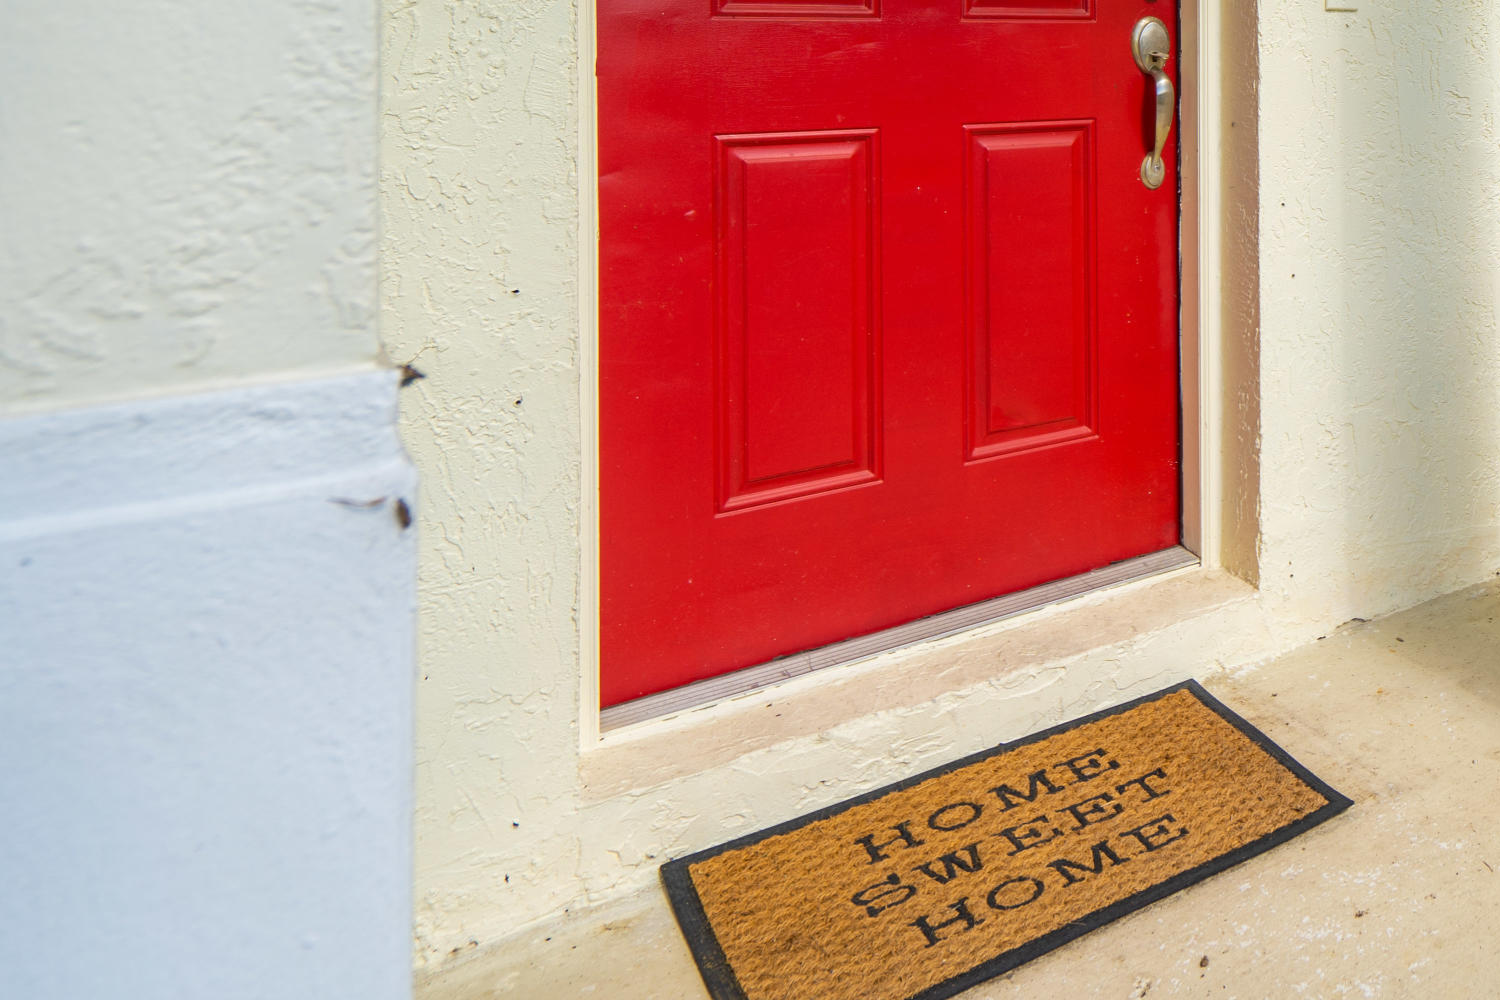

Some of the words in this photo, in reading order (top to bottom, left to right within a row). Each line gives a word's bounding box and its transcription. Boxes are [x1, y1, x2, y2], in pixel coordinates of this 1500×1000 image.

[851, 767, 1170, 918] SWEET
[854, 748, 1122, 864] HOME
[909, 813, 1190, 948] HOME
